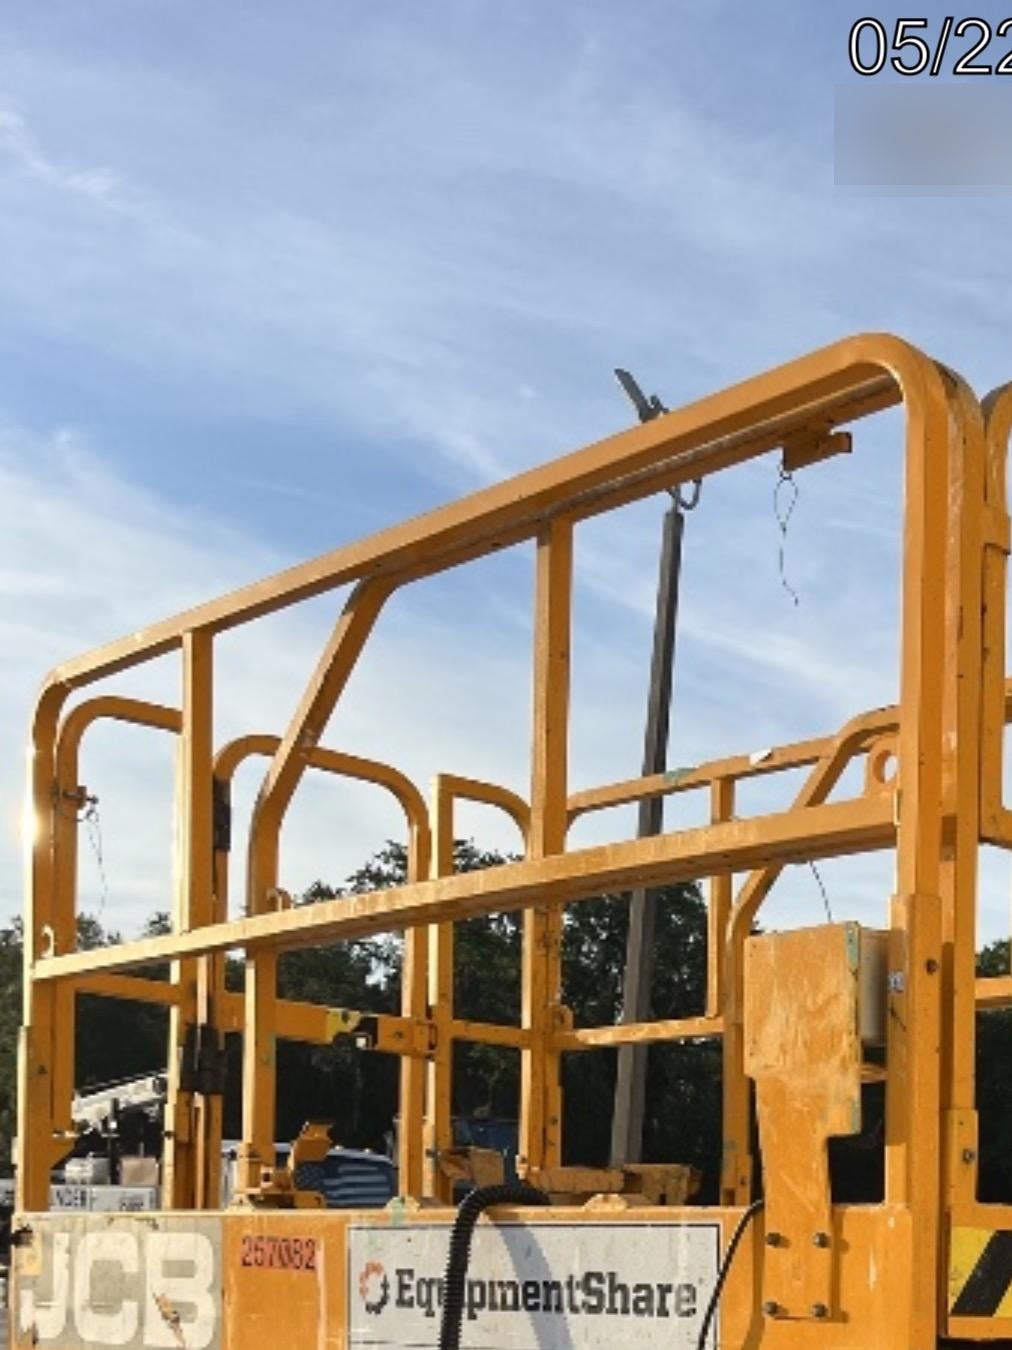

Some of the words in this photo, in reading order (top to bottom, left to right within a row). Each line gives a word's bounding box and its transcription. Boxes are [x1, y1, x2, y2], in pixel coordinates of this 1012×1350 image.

[241, 1235, 316, 1271] 257082
[19, 1231, 217, 1350] JCB
[395, 1268, 697, 1321] EqpmentShare
